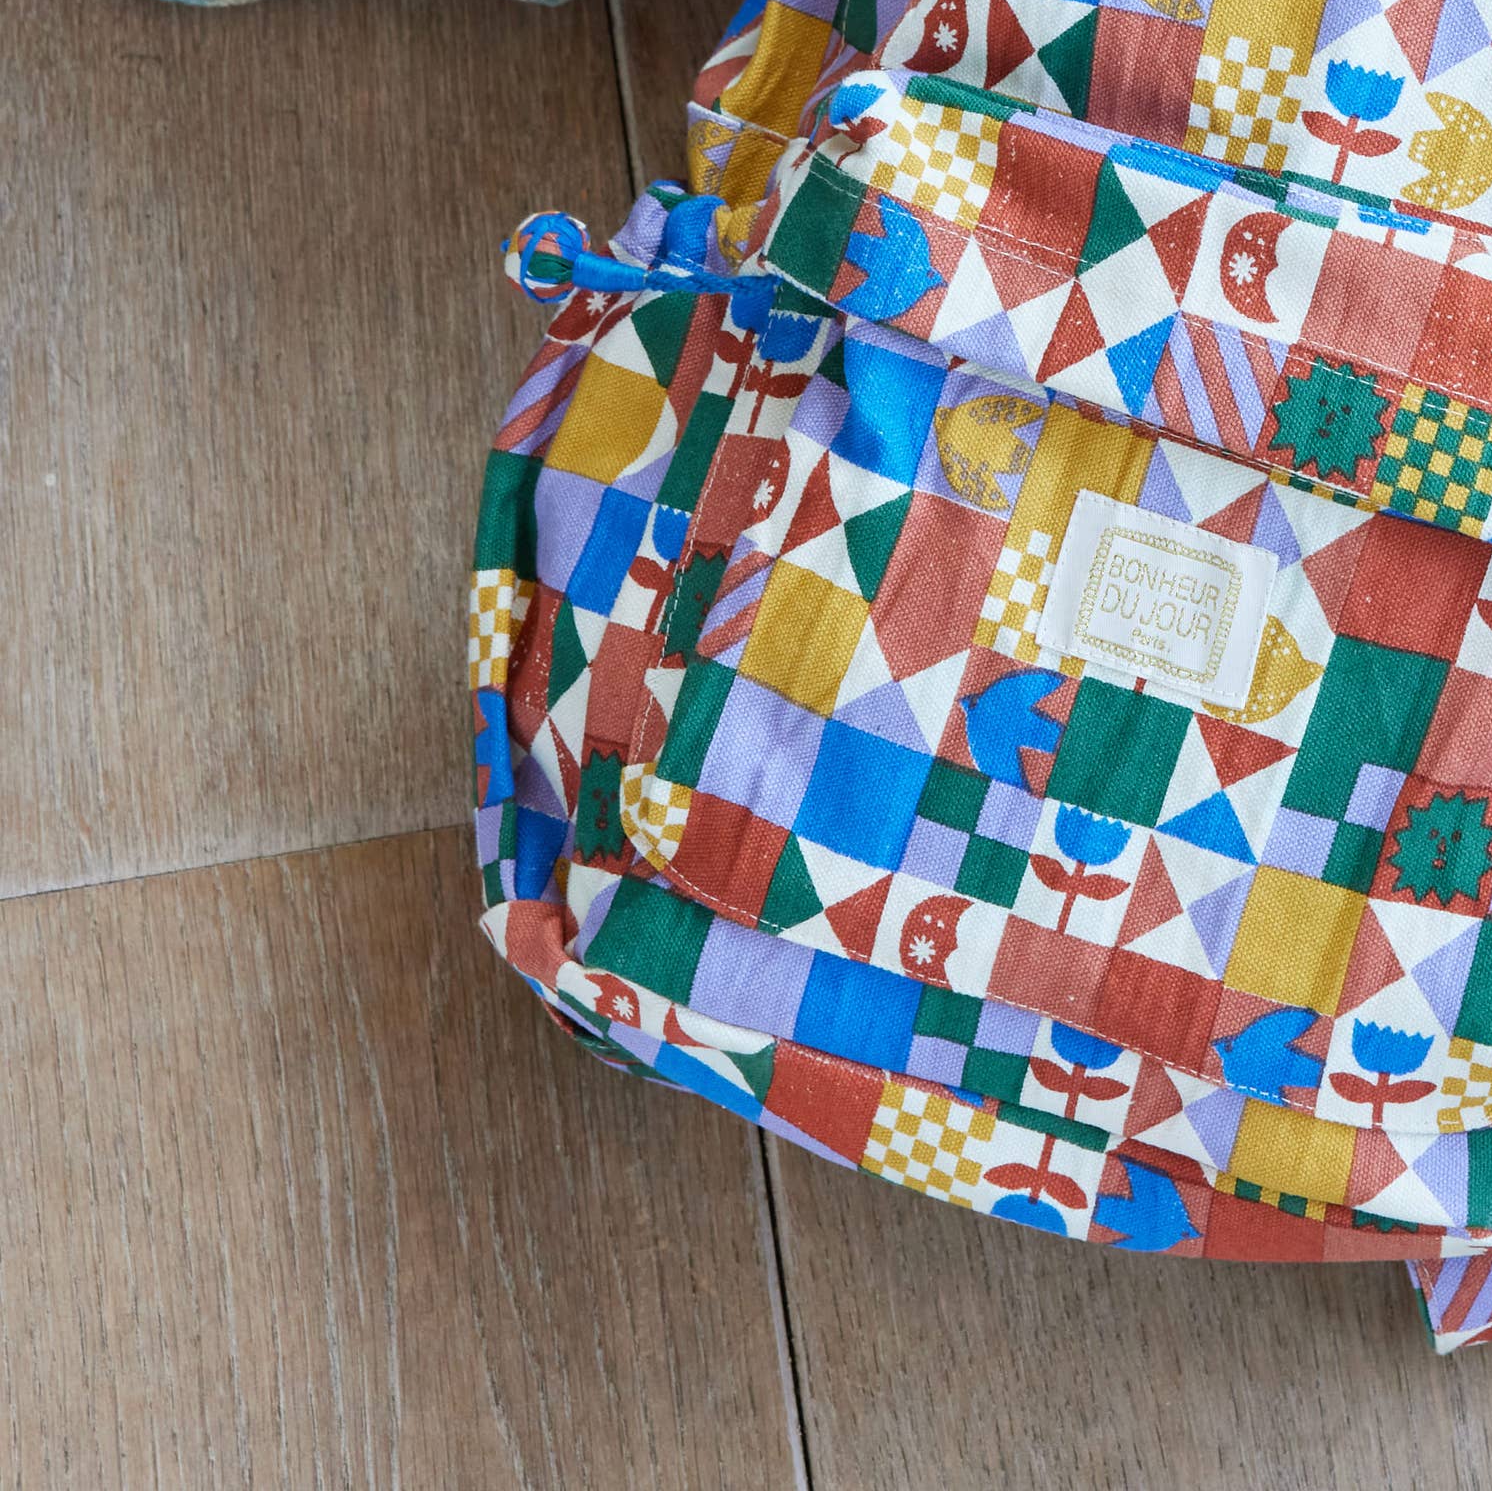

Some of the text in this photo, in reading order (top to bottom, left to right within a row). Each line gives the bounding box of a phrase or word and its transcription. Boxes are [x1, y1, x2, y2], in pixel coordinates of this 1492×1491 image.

[1109, 554, 1221, 611] BONHEUR
[1100, 583, 1212, 645] DU JOUR
